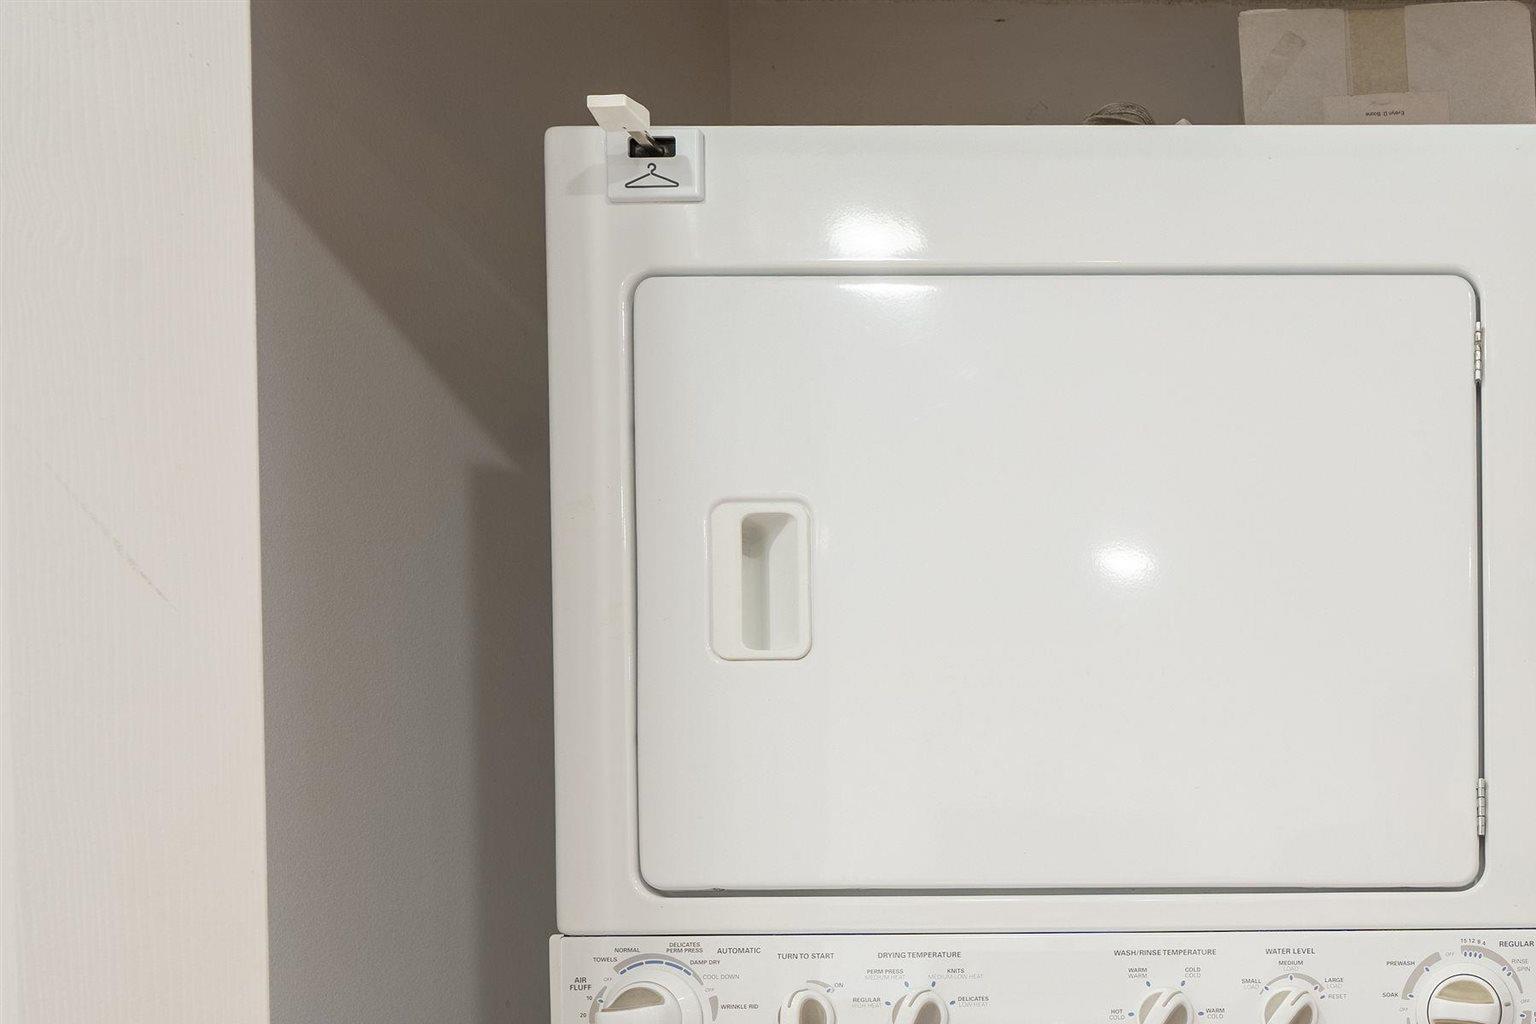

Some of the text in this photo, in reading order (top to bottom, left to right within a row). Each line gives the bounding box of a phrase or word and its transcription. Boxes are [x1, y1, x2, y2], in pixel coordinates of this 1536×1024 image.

[1500, 940, 1534, 948] REGULAR
[811, 952, 834, 960] START
[1163, 948, 1217, 956] TEMPERATURE
[574, 976, 586, 984] AIR
